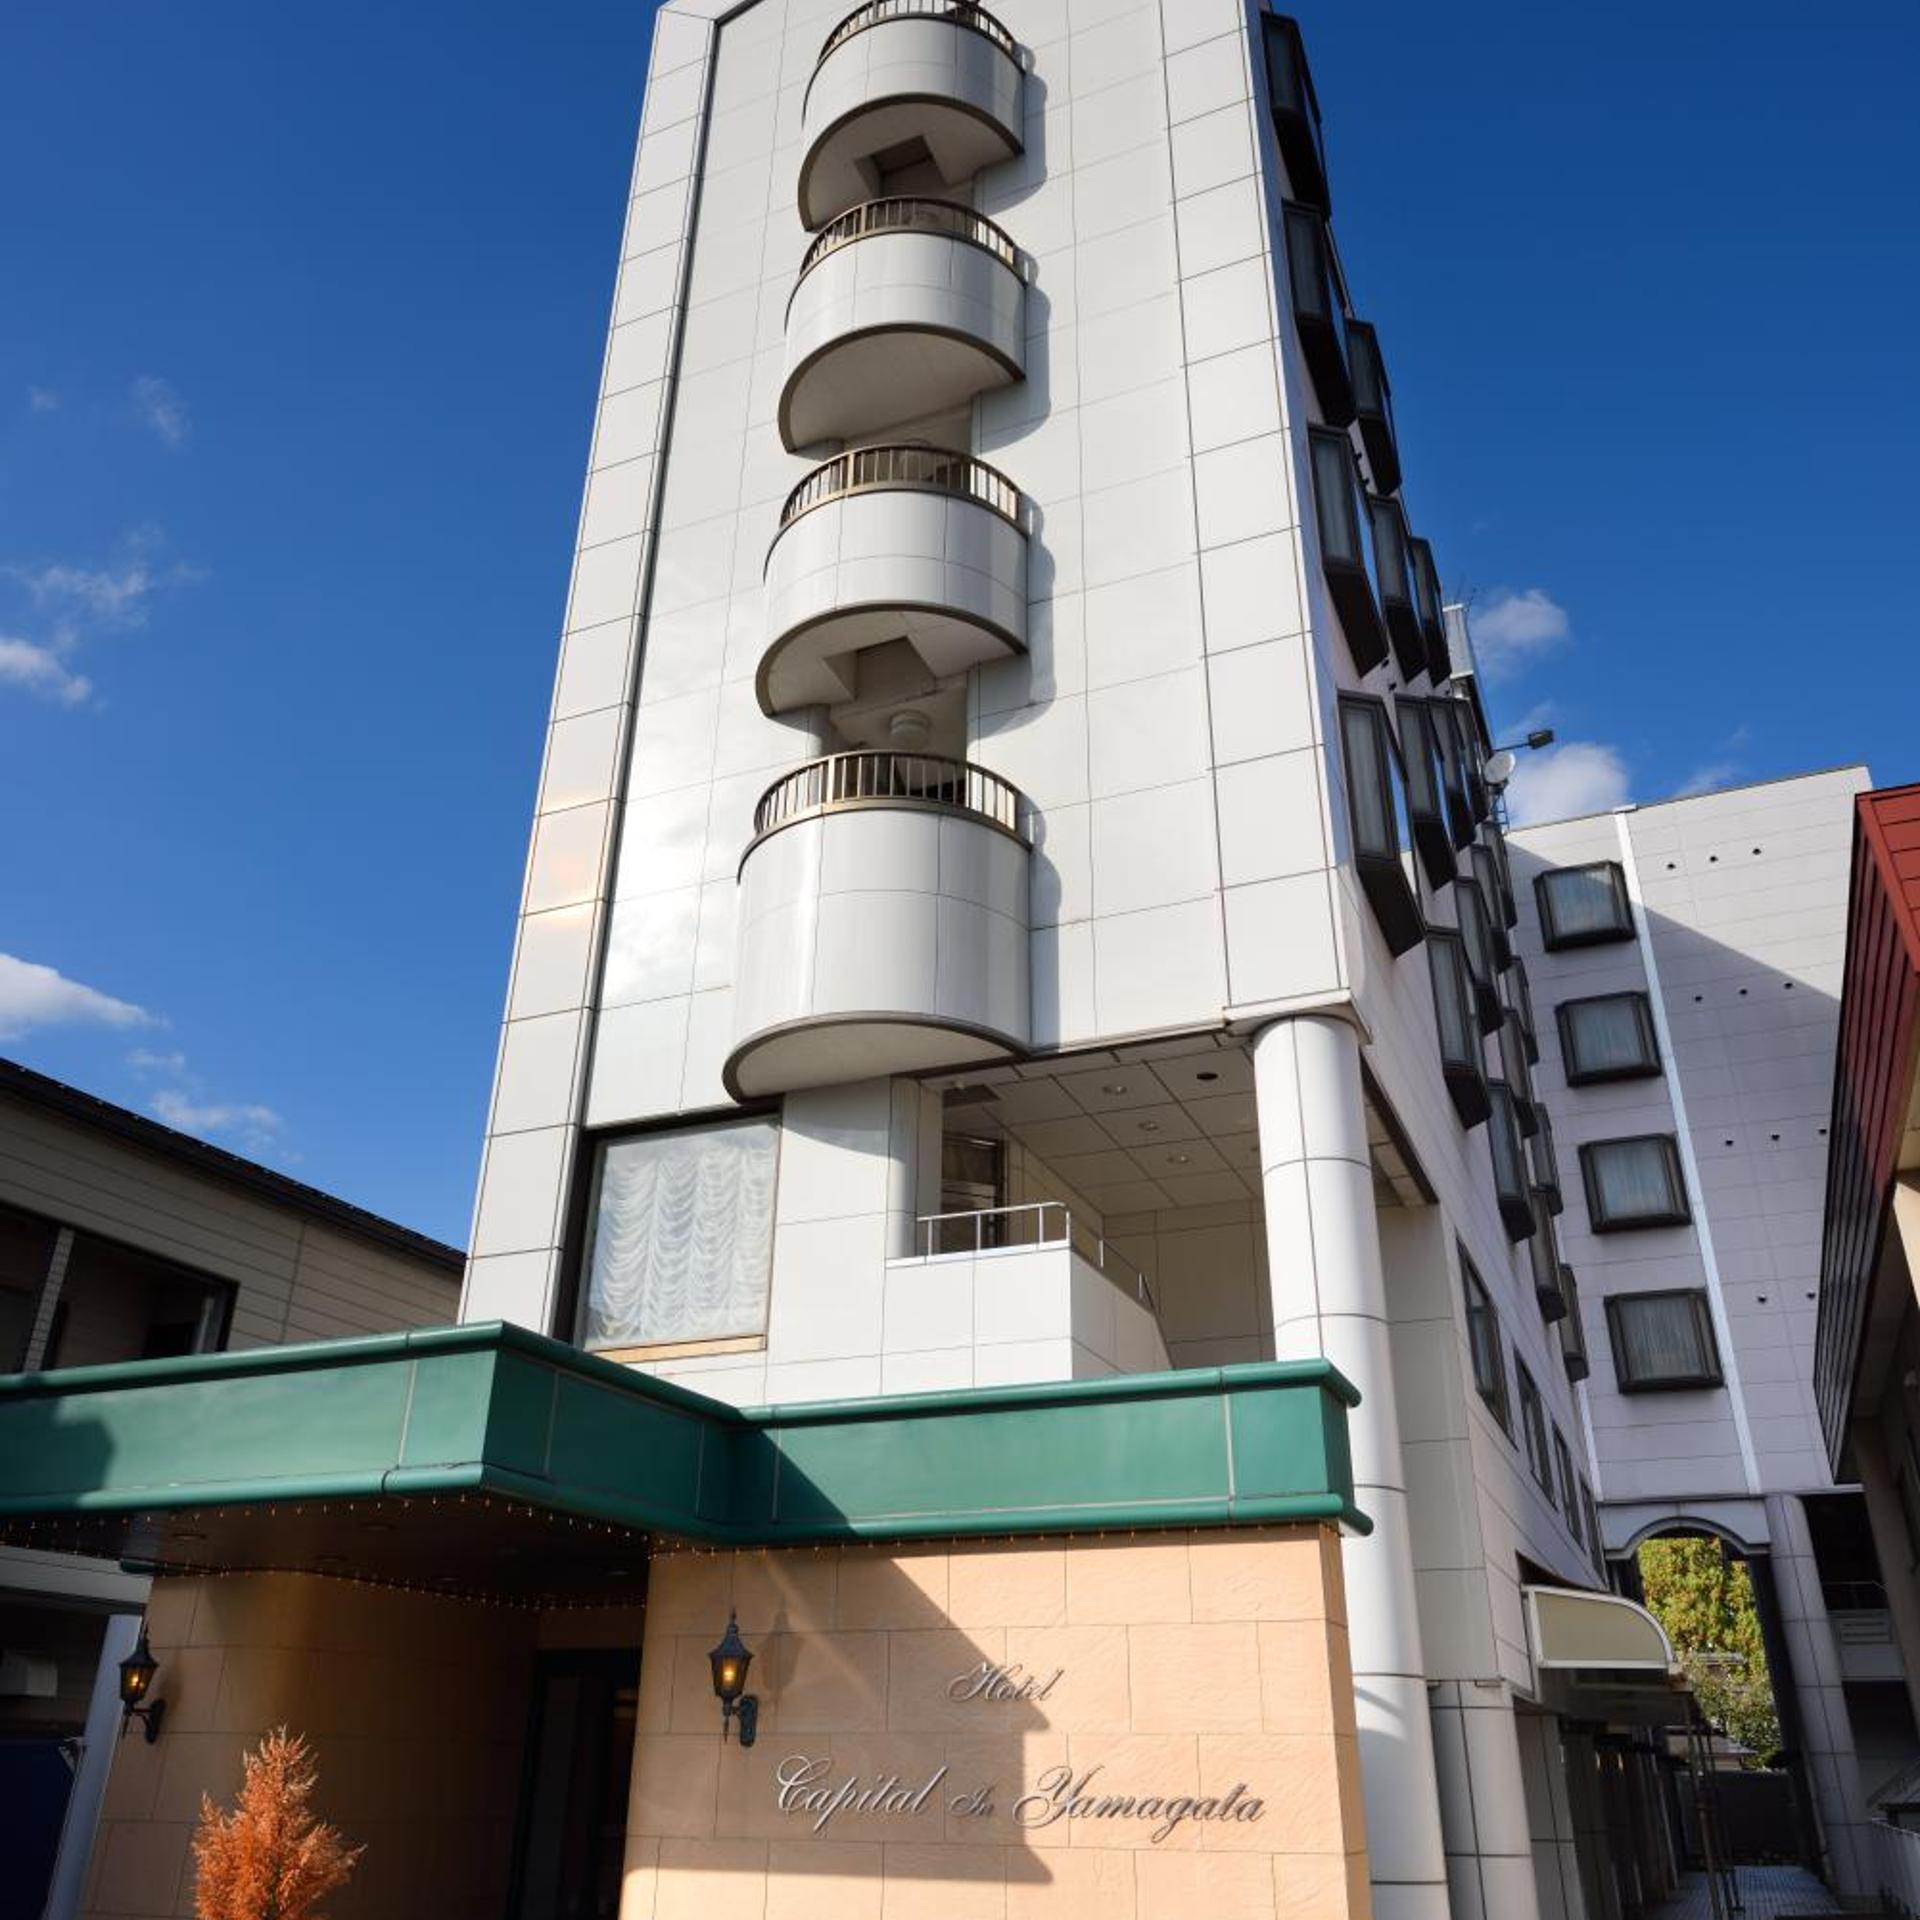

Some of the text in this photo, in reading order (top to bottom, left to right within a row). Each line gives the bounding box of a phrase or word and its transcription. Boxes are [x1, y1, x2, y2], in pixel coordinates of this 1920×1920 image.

[948, 1661, 1064, 1702] Hotel
[776, 1755, 948, 1835] Capital
[1012, 1763, 1266, 1844] Yamagata
